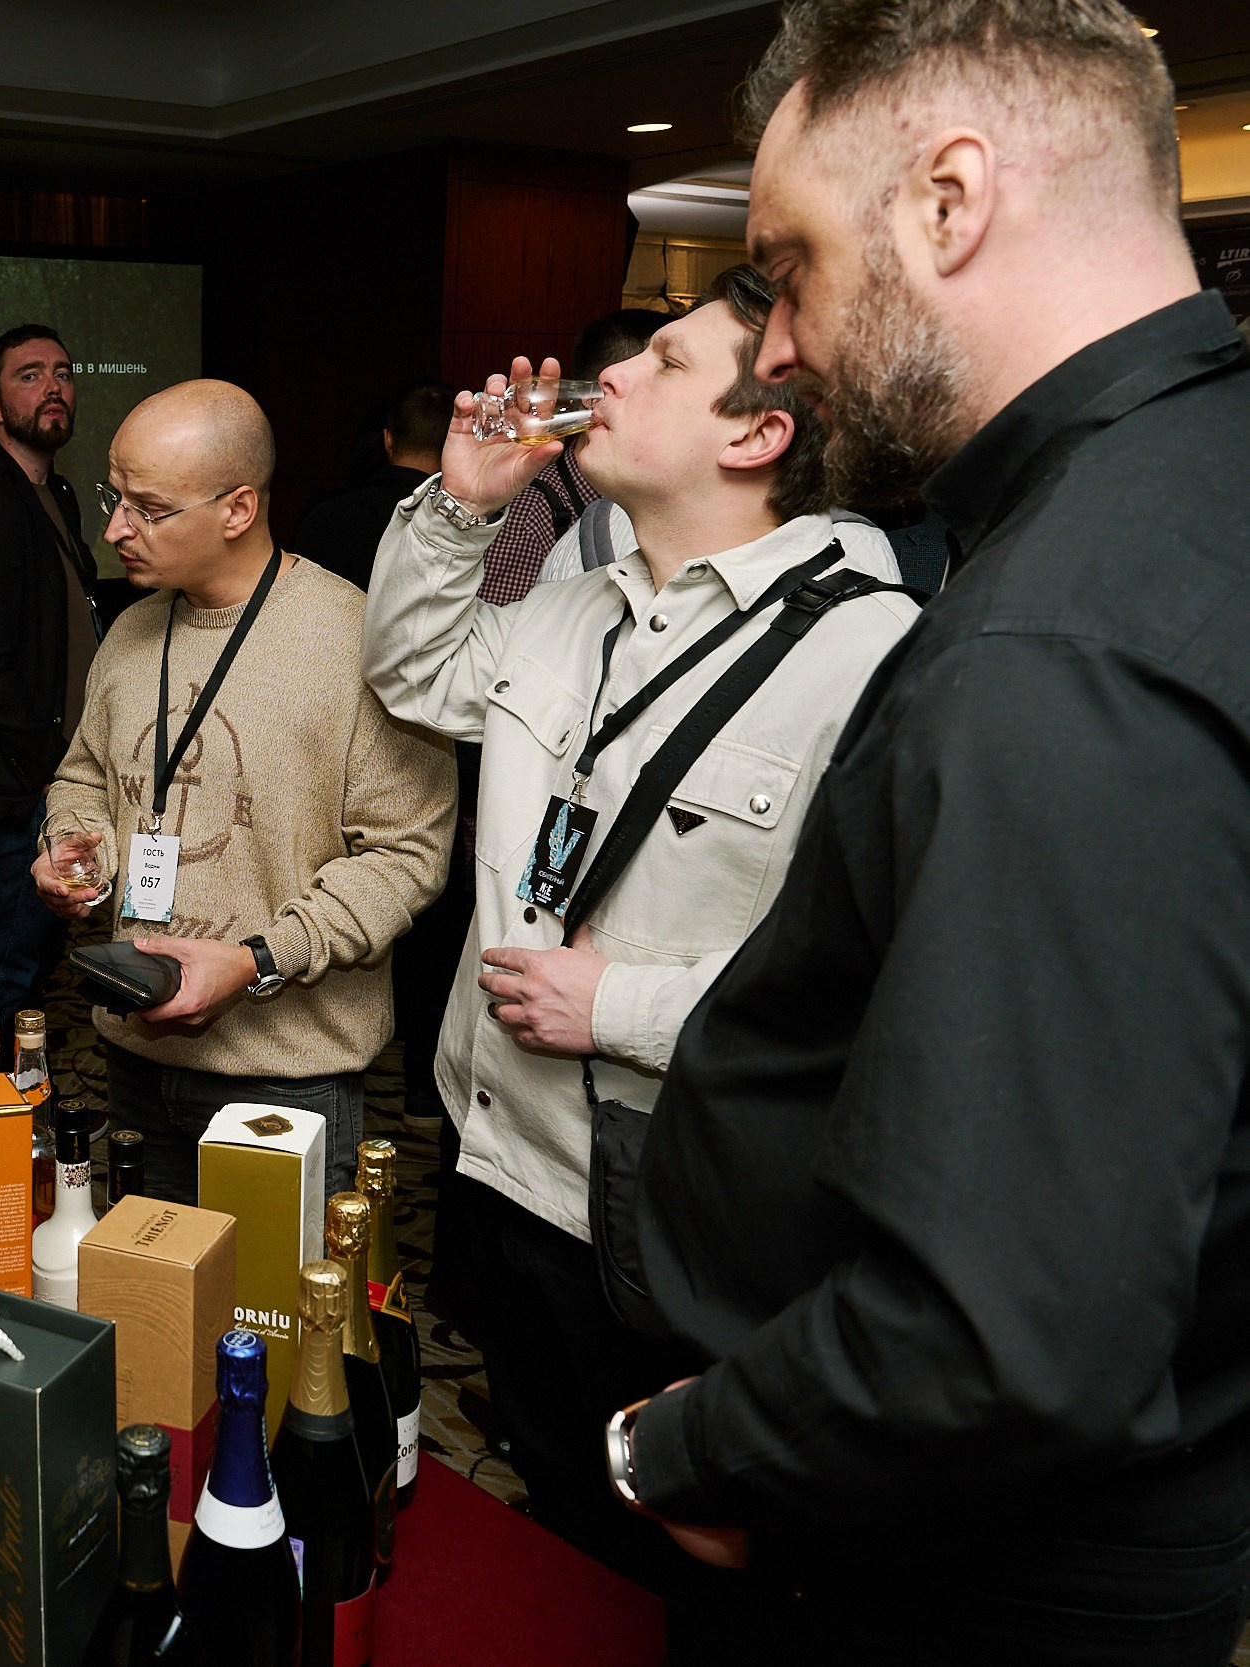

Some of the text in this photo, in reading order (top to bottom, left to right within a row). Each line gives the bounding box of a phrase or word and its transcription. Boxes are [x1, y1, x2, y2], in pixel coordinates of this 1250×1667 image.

[87, 364, 95, 373] в
[98, 362, 148, 374] мишень
[142, 848, 165, 857] ГОСТЬ
[140, 875, 161, 889] 057
[233, 1306, 291, 1330] ORNÍU
